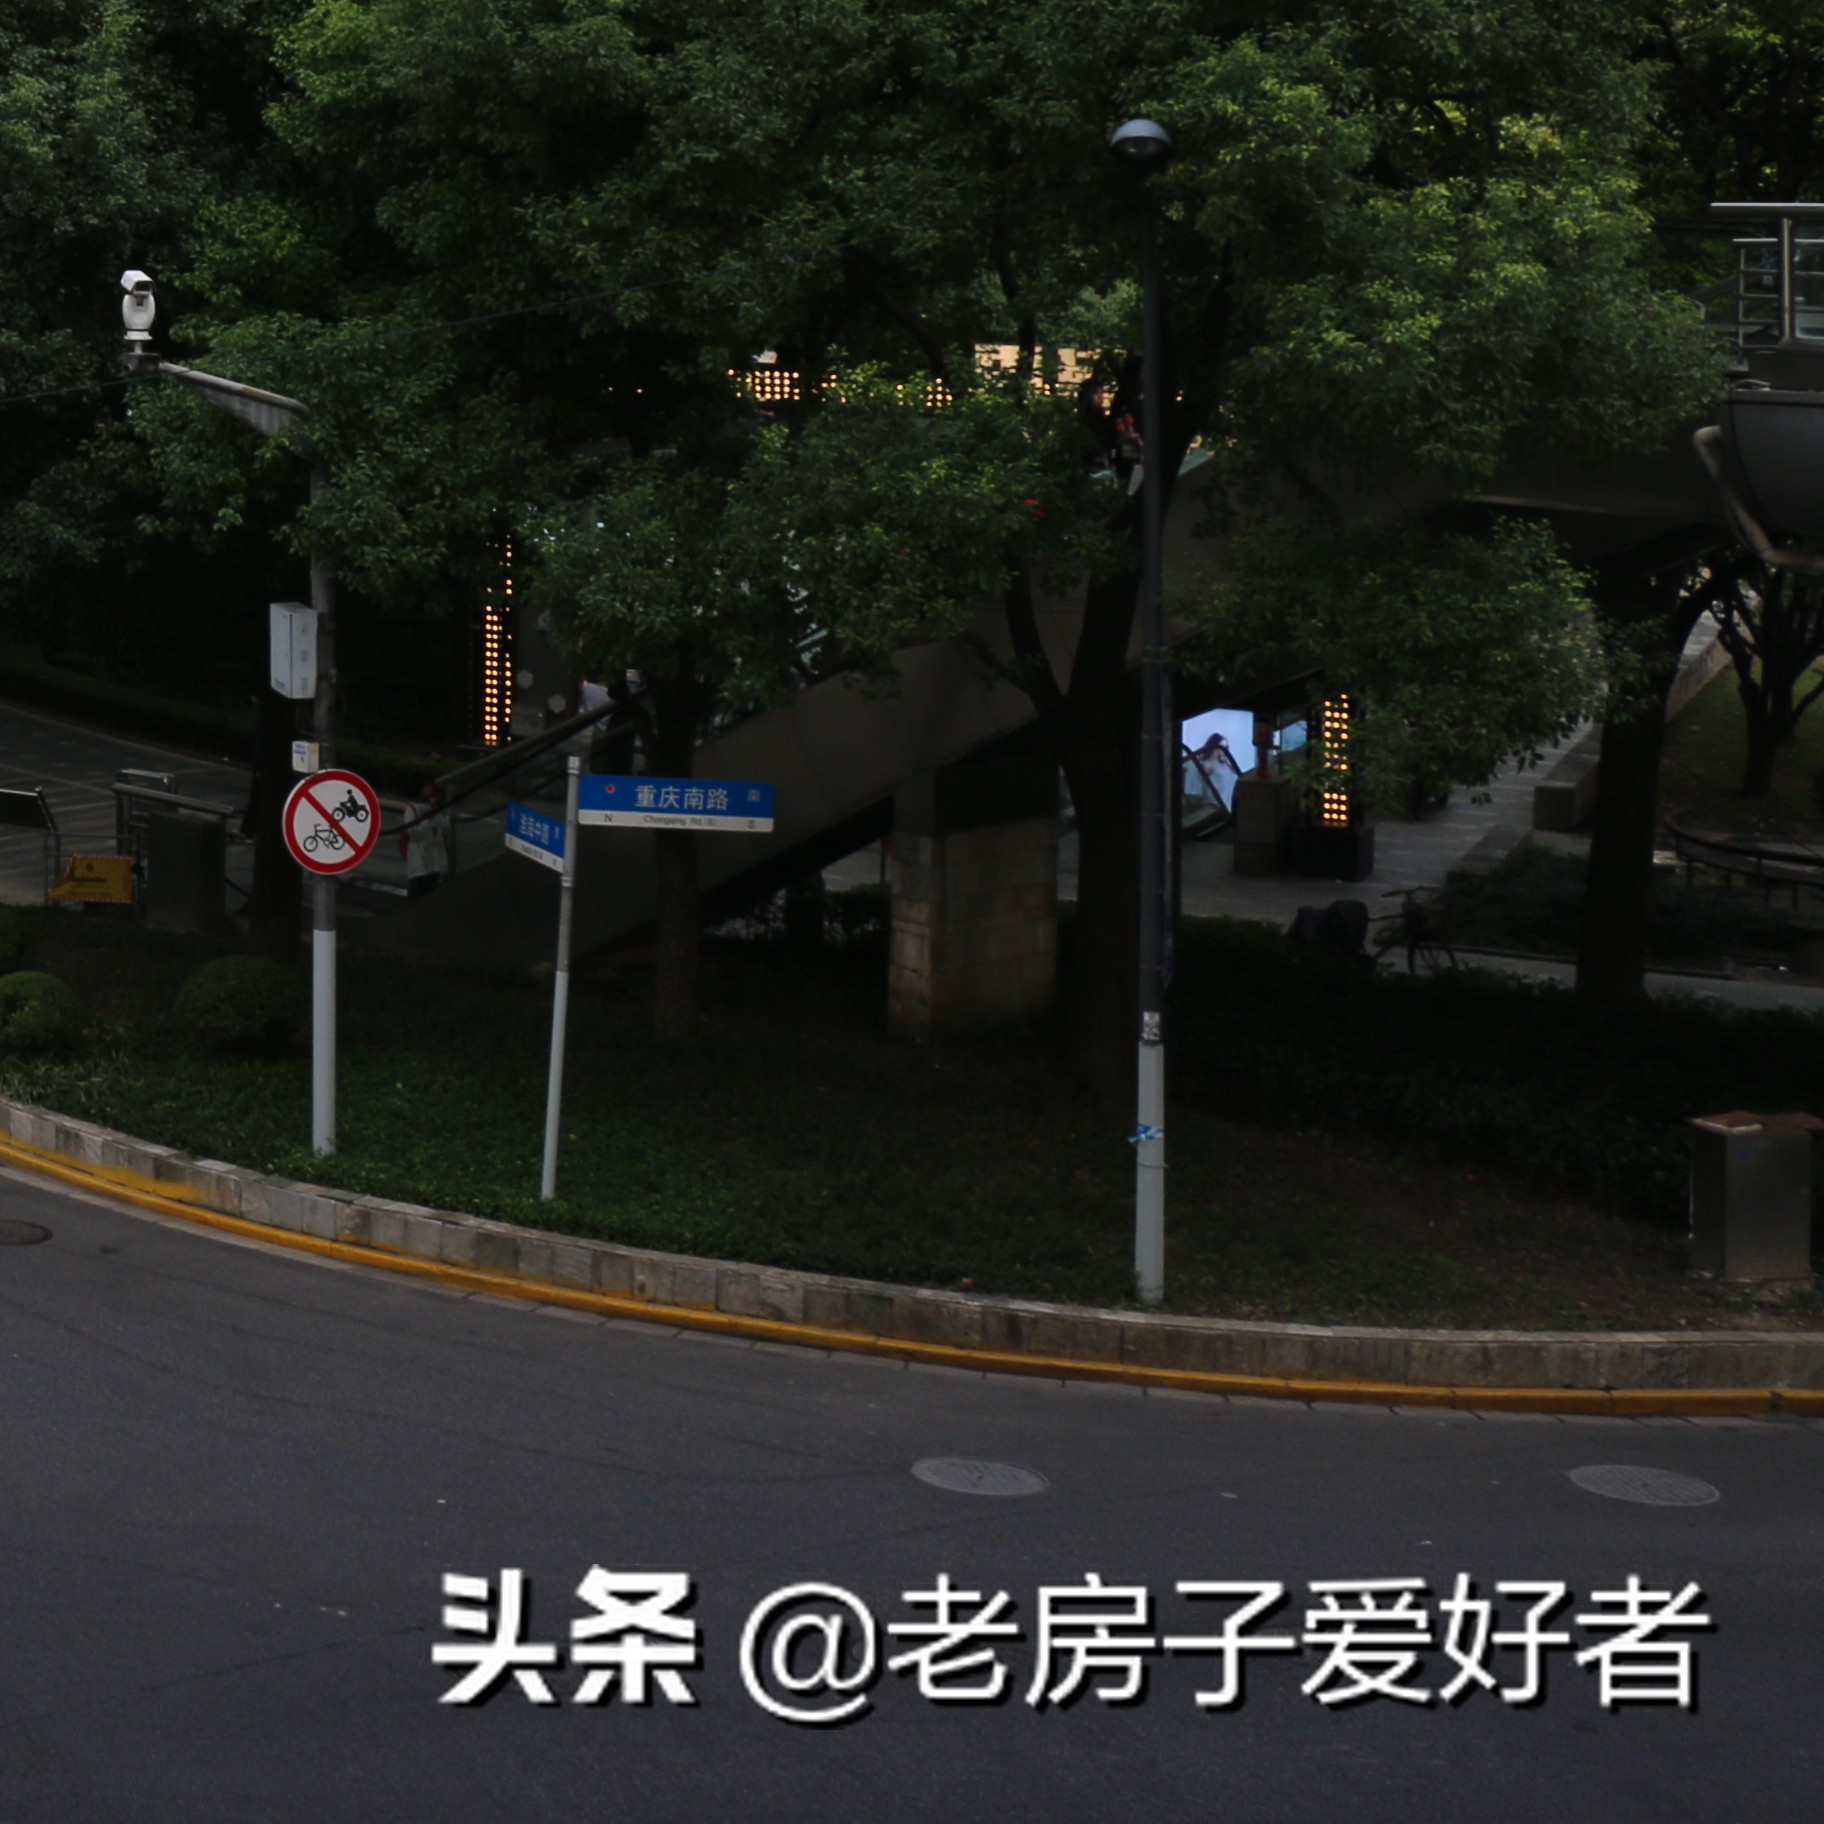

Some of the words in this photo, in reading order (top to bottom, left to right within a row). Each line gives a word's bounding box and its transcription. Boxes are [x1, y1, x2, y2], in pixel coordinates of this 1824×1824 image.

[634, 785, 729, 810] 重庆南路
[604, 813, 613, 823] N
[748, 819, 756, 830] S
